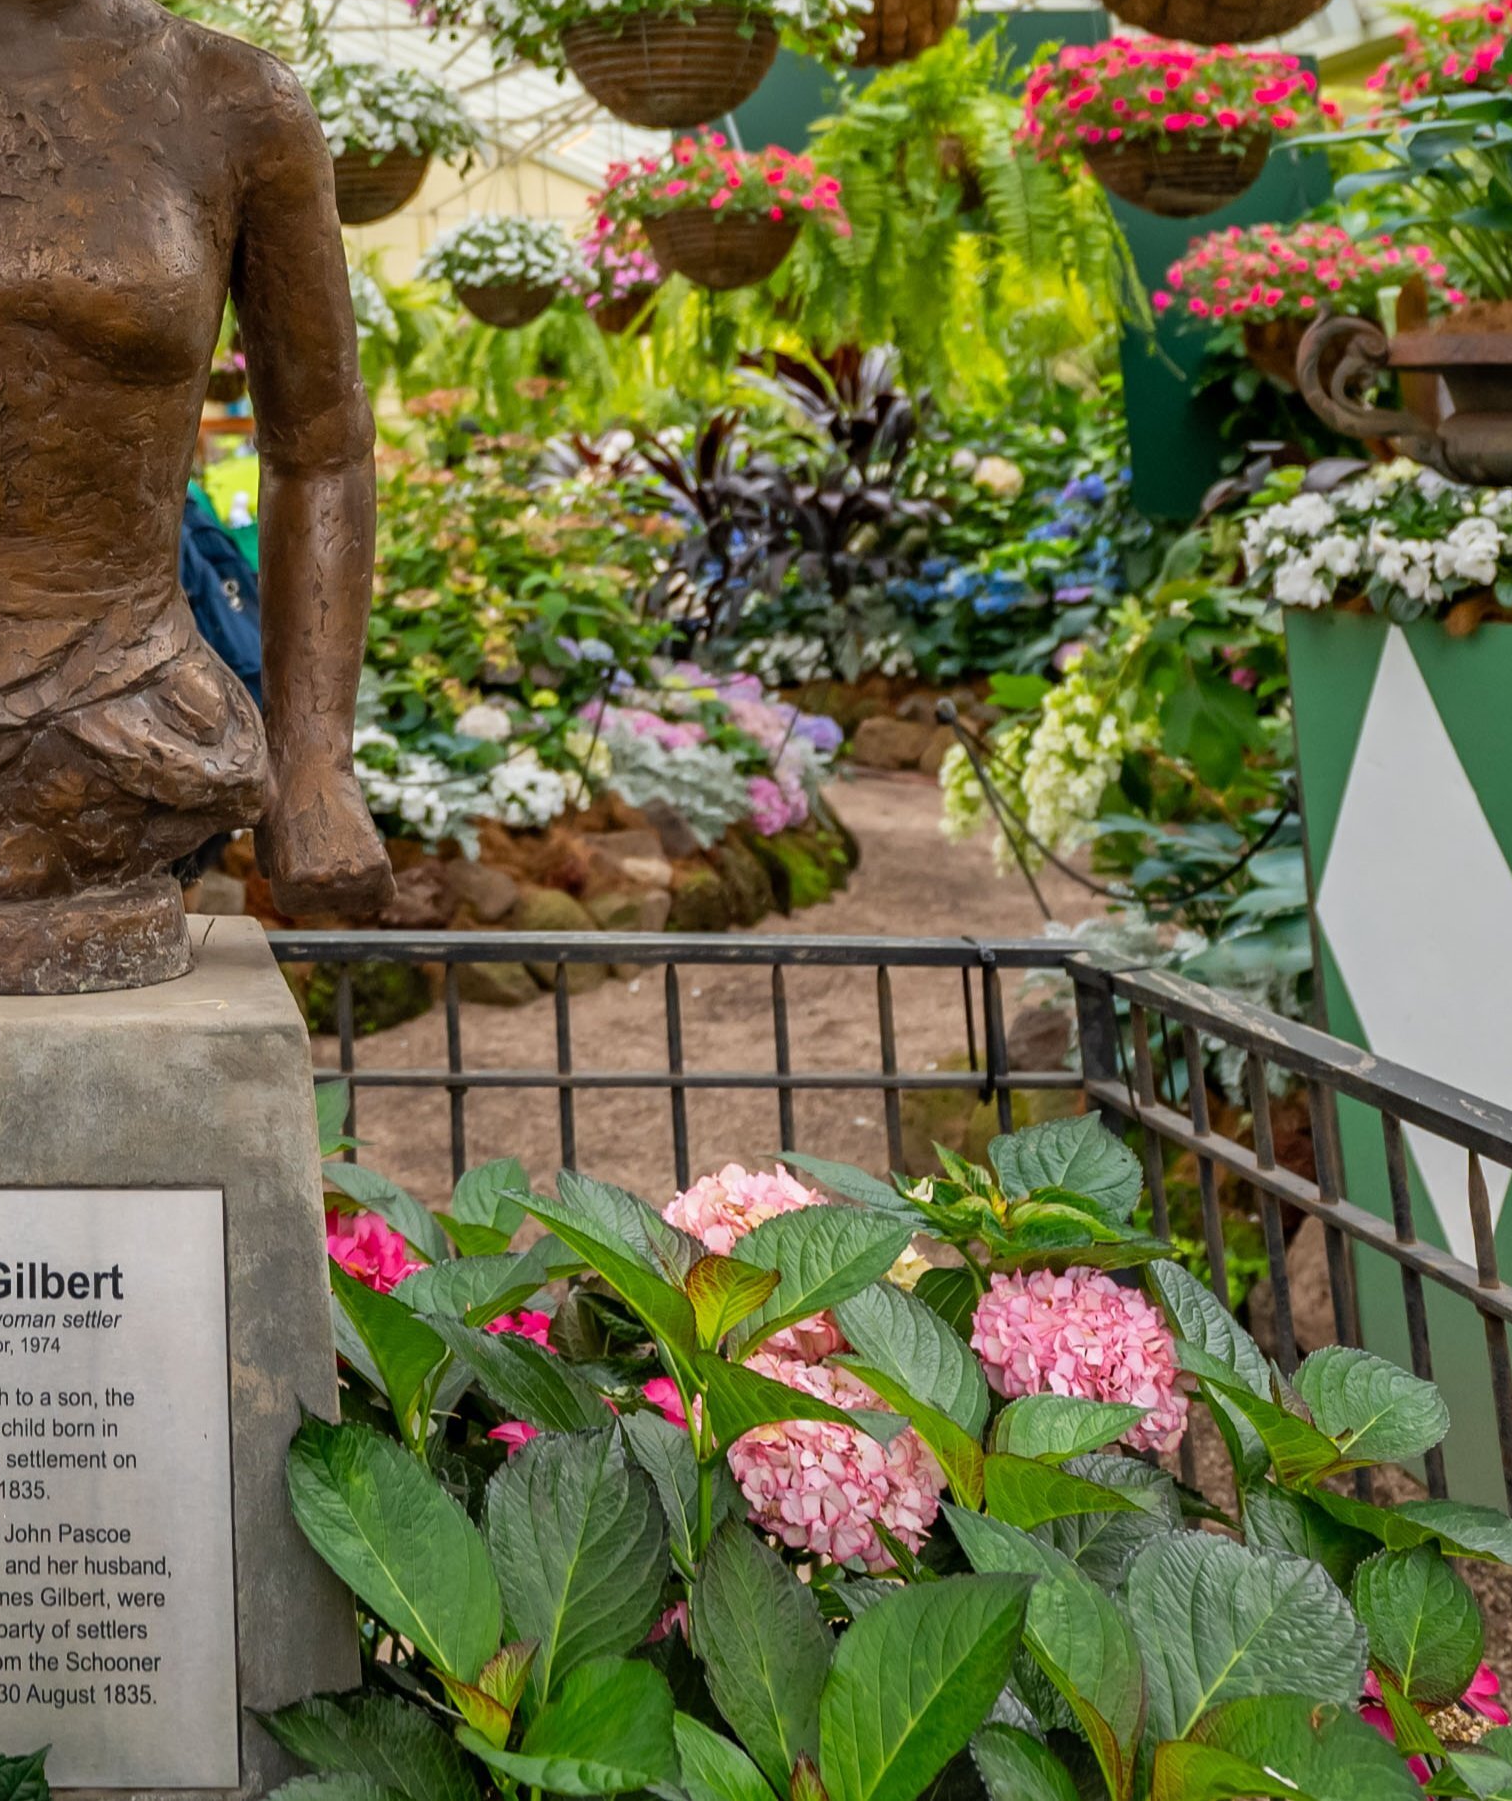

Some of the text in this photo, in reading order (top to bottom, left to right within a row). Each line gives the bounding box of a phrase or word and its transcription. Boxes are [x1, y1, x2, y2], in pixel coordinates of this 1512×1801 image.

[61, 1310, 123, 1329] settler
[20, 1337, 61, 1353] 1974
[15, 1388, 34, 1406] to
[39, 1392, 52, 1406] a
[57, 1392, 98, 1409] son,
[104, 1388, 135, 1407] the
[1, 1418, 46, 1437] child
[52, 1418, 95, 1437] born
[102, 1418, 118, 1437] in
[6, 1449, 108, 1469] settlement
[112, 1454, 137, 1469] on
[3, 1523, 52, 1543] John
[58, 1523, 132, 1543] Pascoe
[5, 1555, 41, 1575] and
[47, 1555, 79, 1575] her
[84, 1556, 172, 1578] husband,
[40, 1587, 111, 1609] Gilbert,
[116, 1592, 166, 1607] were
[51, 1619, 71, 1639] of
[76, 1620, 148, 1639] settlers
[28, 1651, 59, 1671] the
[66, 1651, 162, 1672] Schooner
[25, 1684, 96, 1709] August
[103, 1684, 157, 1704] 1835.
